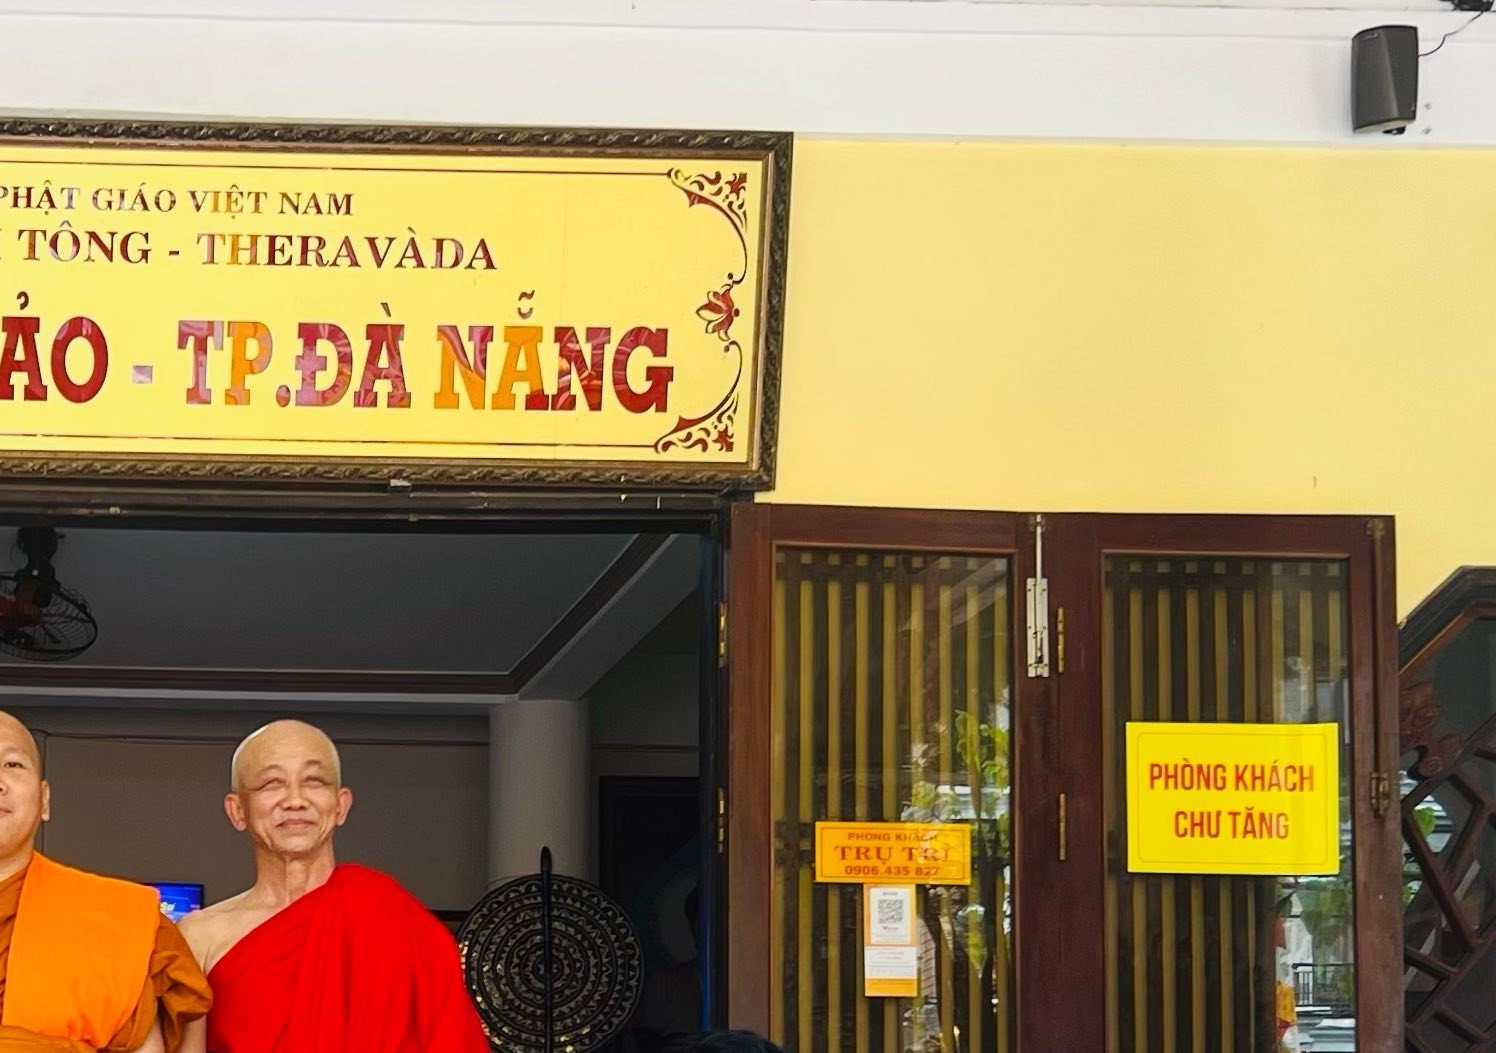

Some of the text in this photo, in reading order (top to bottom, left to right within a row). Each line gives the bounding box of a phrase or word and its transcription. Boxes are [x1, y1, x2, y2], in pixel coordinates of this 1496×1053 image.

[92, 182, 176, 213] GIÁO
[189, 184, 267, 219] VIỆT
[278, 191, 354, 217] NAM
[18, 220, 152, 264] TÔNG
[197, 226, 497, 270] THERAVÀDA
[132, 364, 153, 384] -
[177, 302, 412, 409] TP.ĐÀ
[433, 290, 675, 414] NẴNG
[1150, 758, 1314, 792] PHÒNG KHÁCH
[1174, 806, 1289, 839] CHƯ TĂNG
[834, 845, 893, 865] TRỤ
[845, 865, 940, 876] 0906 435 827
